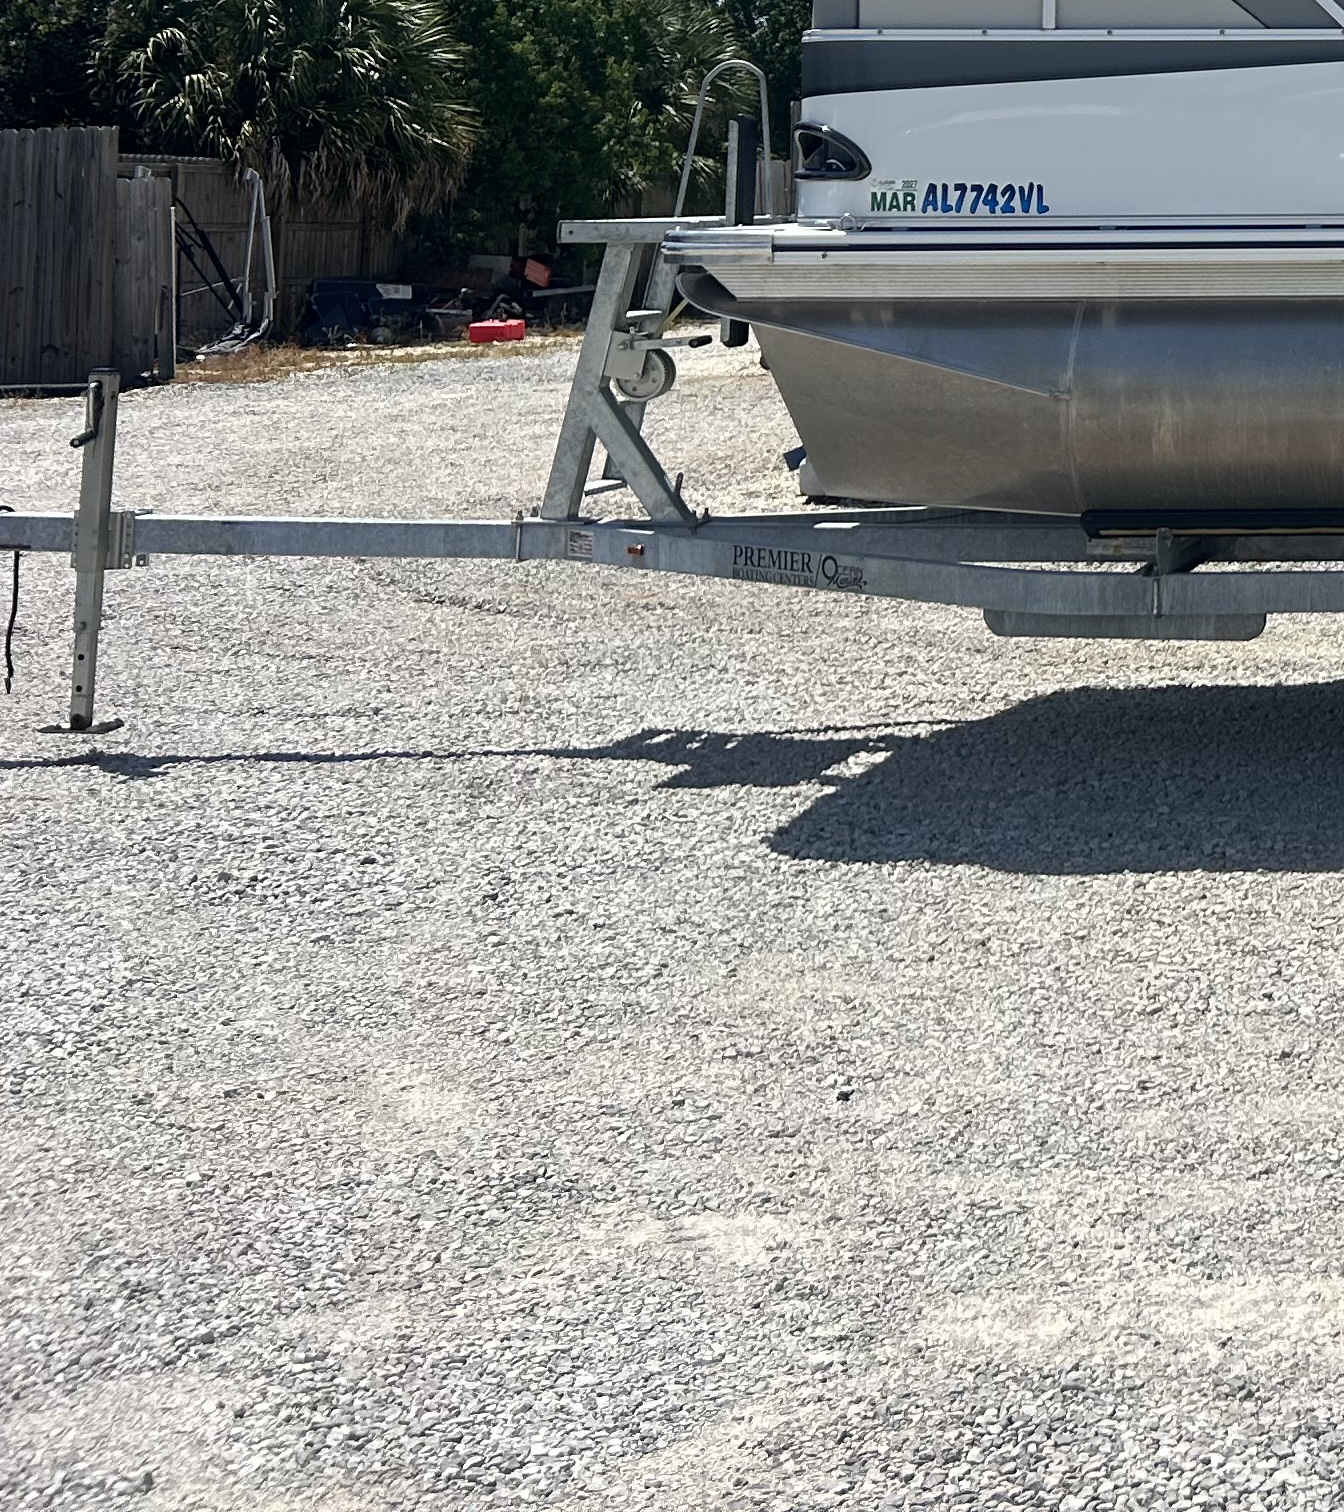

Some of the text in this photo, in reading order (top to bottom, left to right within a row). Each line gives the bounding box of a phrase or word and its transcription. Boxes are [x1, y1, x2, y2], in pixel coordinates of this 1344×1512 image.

[870, 191, 916, 212] MAR
[921, 182, 1050, 214] AL7742VL
[732, 544, 814, 574] PREMIER
[732, 566, 814, 588] BOATING CENTERS
